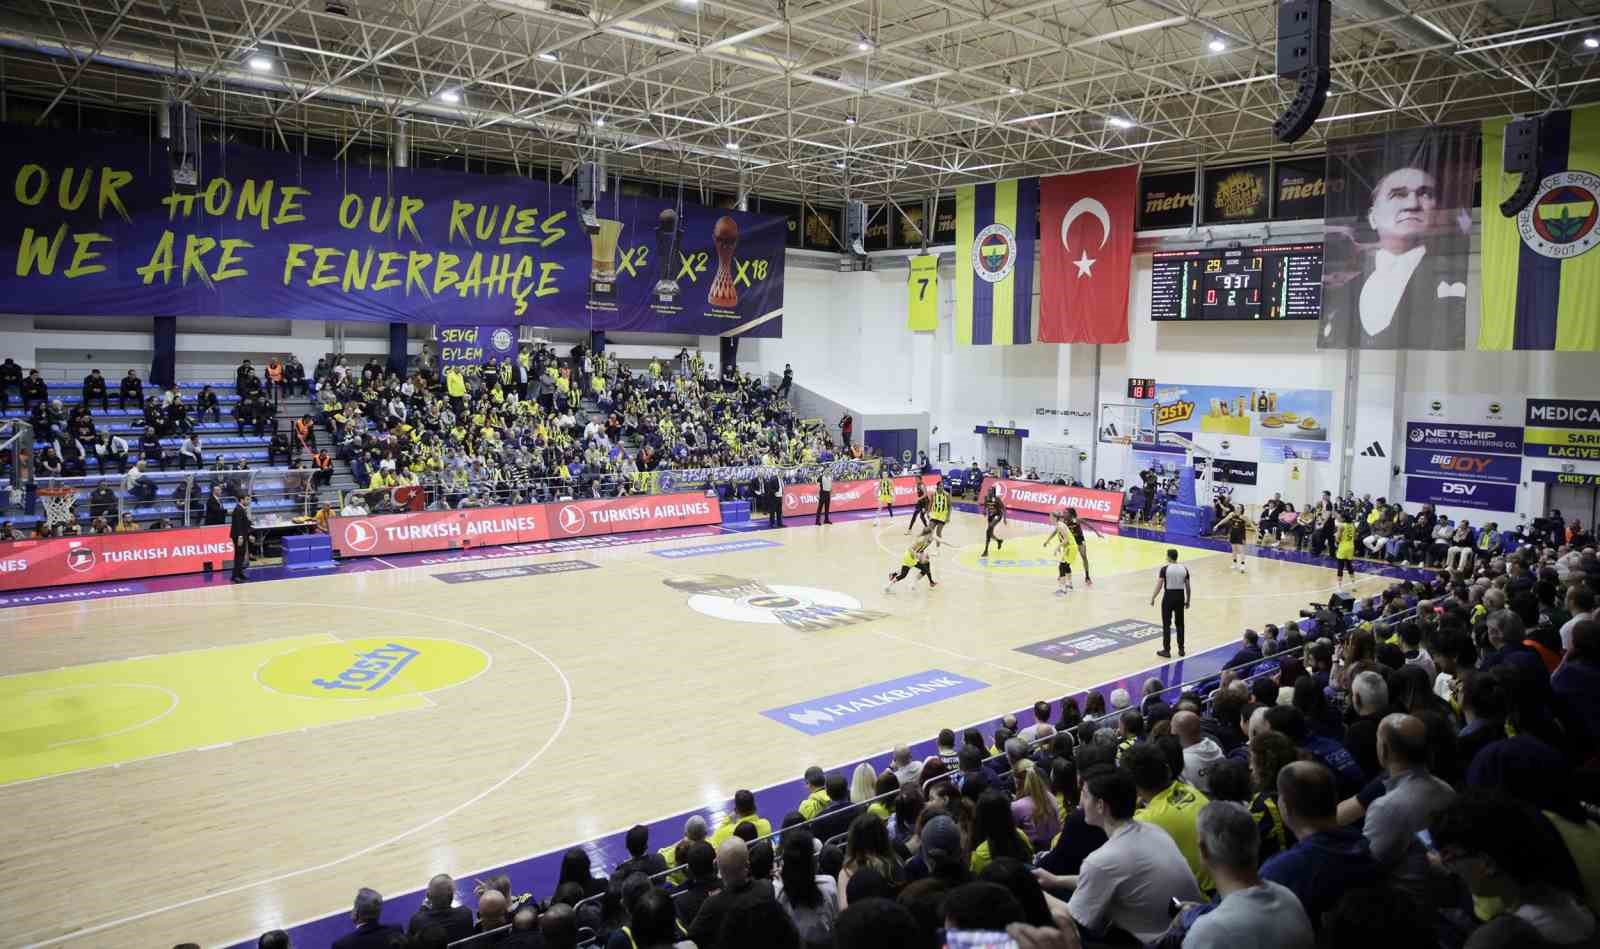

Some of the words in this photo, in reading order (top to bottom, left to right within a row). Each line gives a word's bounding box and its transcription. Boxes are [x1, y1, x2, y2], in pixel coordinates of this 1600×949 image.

[14, 163, 133, 225] OUR
[338, 193, 424, 245] OUR
[448, 199, 567, 248] RULES
[1548, 244, 1576, 256] 1907
[15, 222, 113, 281] WE
[136, 228, 255, 292] ARE
[282, 242, 567, 316] FENERBAHÇE
[732, 257, 769, 288] X18
[1207, 259, 1221, 271] 29
[917, 278, 929, 302] 7
[1207, 289, 1216, 303] 0
[1227, 290, 1237, 303] 2
[441, 326, 480, 344] SEVGİ
[441, 346, 483, 361] EYLEM
[1425, 428, 1497, 439] NETSHIP
[1459, 439, 1503, 448] CHARTERING
[1442, 482, 1477, 495] DSV
[1010, 489, 1057, 505] TURKISH
[1058, 495, 1112, 513] AIRLINES
[590, 507, 650, 523] TURKISH
[653, 502, 710, 519] AIRLINES
[384, 522, 461, 541] TURKISH
[465, 516, 536, 535] AIRLINES
[102, 549, 168, 563] TURKISH
[172, 541, 235, 558] AIRLINES
[311, 642, 420, 691] fasty
[823, 675, 965, 717] HALKBANK
